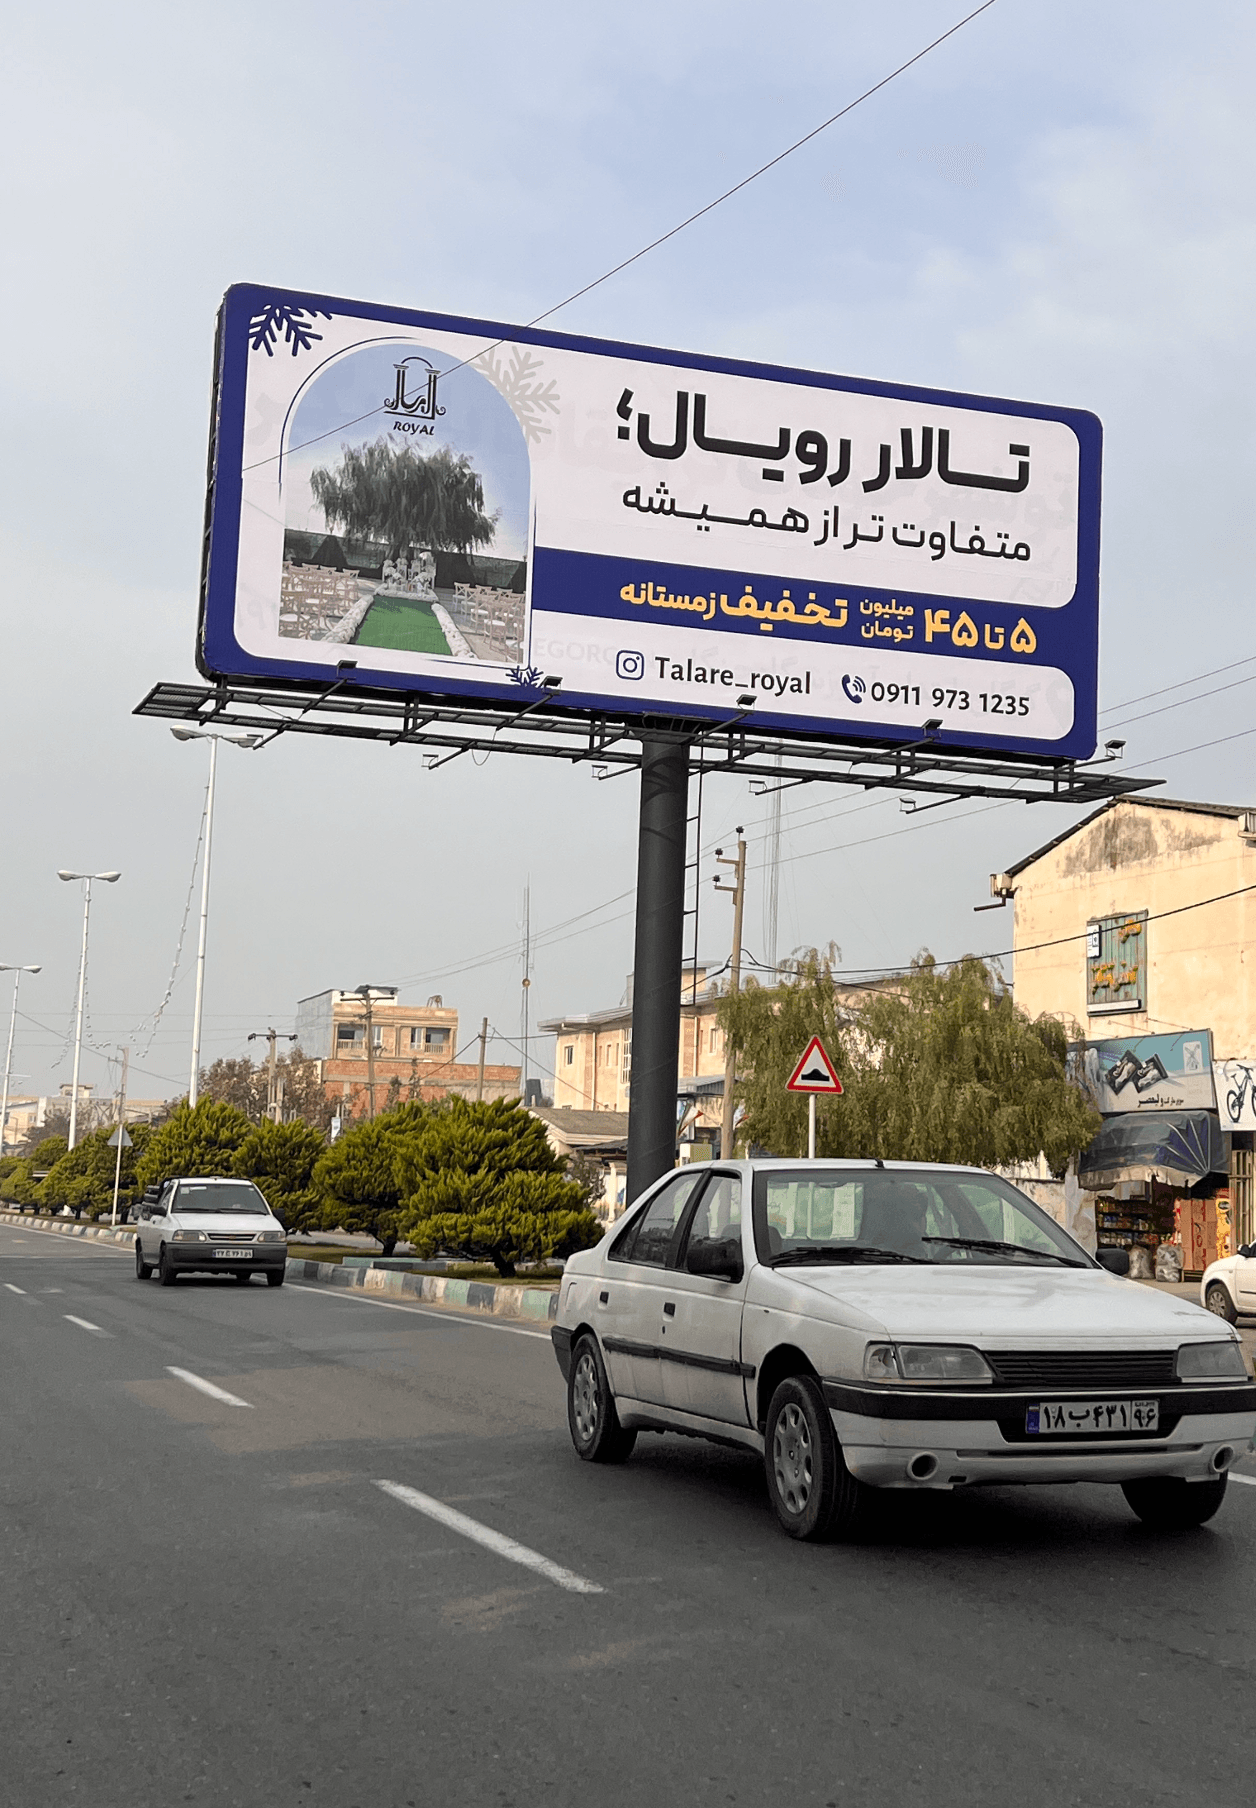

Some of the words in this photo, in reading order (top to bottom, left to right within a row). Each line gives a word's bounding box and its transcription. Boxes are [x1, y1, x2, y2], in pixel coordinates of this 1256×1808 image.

[393, 421, 435, 436] ROYAL
[862, 425, 1030, 494] تالار
[622, 482, 810, 534] همیشه
[813, 505, 839, 547] از
[842, 514, 884, 550] تر
[892, 515, 1031, 562] متفاوت
[620, 582, 716, 621] زمستانه
[719, 586, 848, 632] تخفیف
[860, 598, 914, 618] میلیون
[861, 619, 914, 642] تومان
[924, 609, 979, 648] ۴۵
[985, 622, 1005, 650] تا
[1011, 618, 1037, 654] ۵
[654, 656, 811, 696] Talare_royal
[872, 682, 921, 706] 0911
[932, 688, 970, 711] 973
[980, 694, 1030, 717] 1235
[1133, 1408, 1156, 1430] ۹۶
